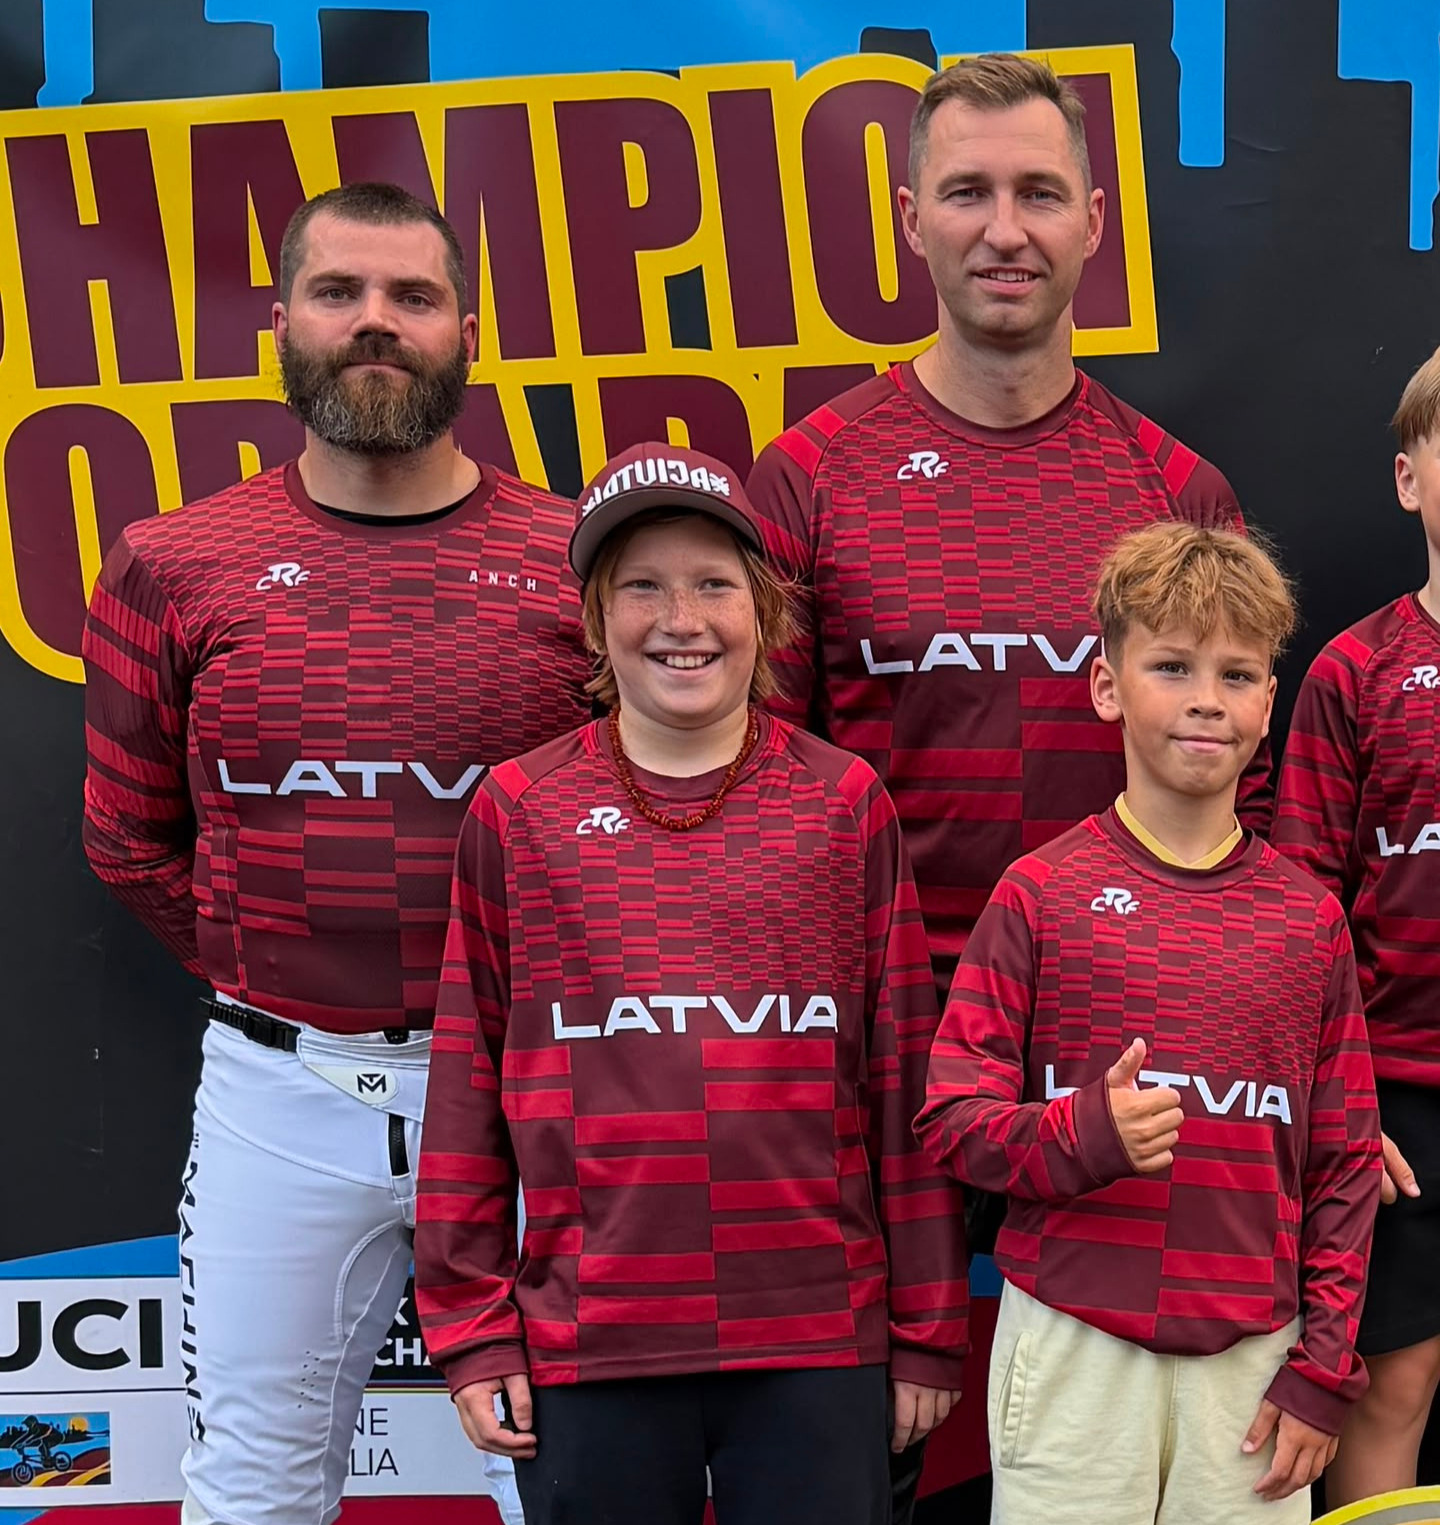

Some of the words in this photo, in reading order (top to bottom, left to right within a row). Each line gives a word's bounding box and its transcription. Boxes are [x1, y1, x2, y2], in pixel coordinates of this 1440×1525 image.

[469, 570, 537, 592] ANCH
[860, 632, 1106, 674] LATV
[217, 759, 494, 799] LATV
[551, 995, 838, 1040] LATVIA
[1045, 1064, 1293, 1125] LTVIA
